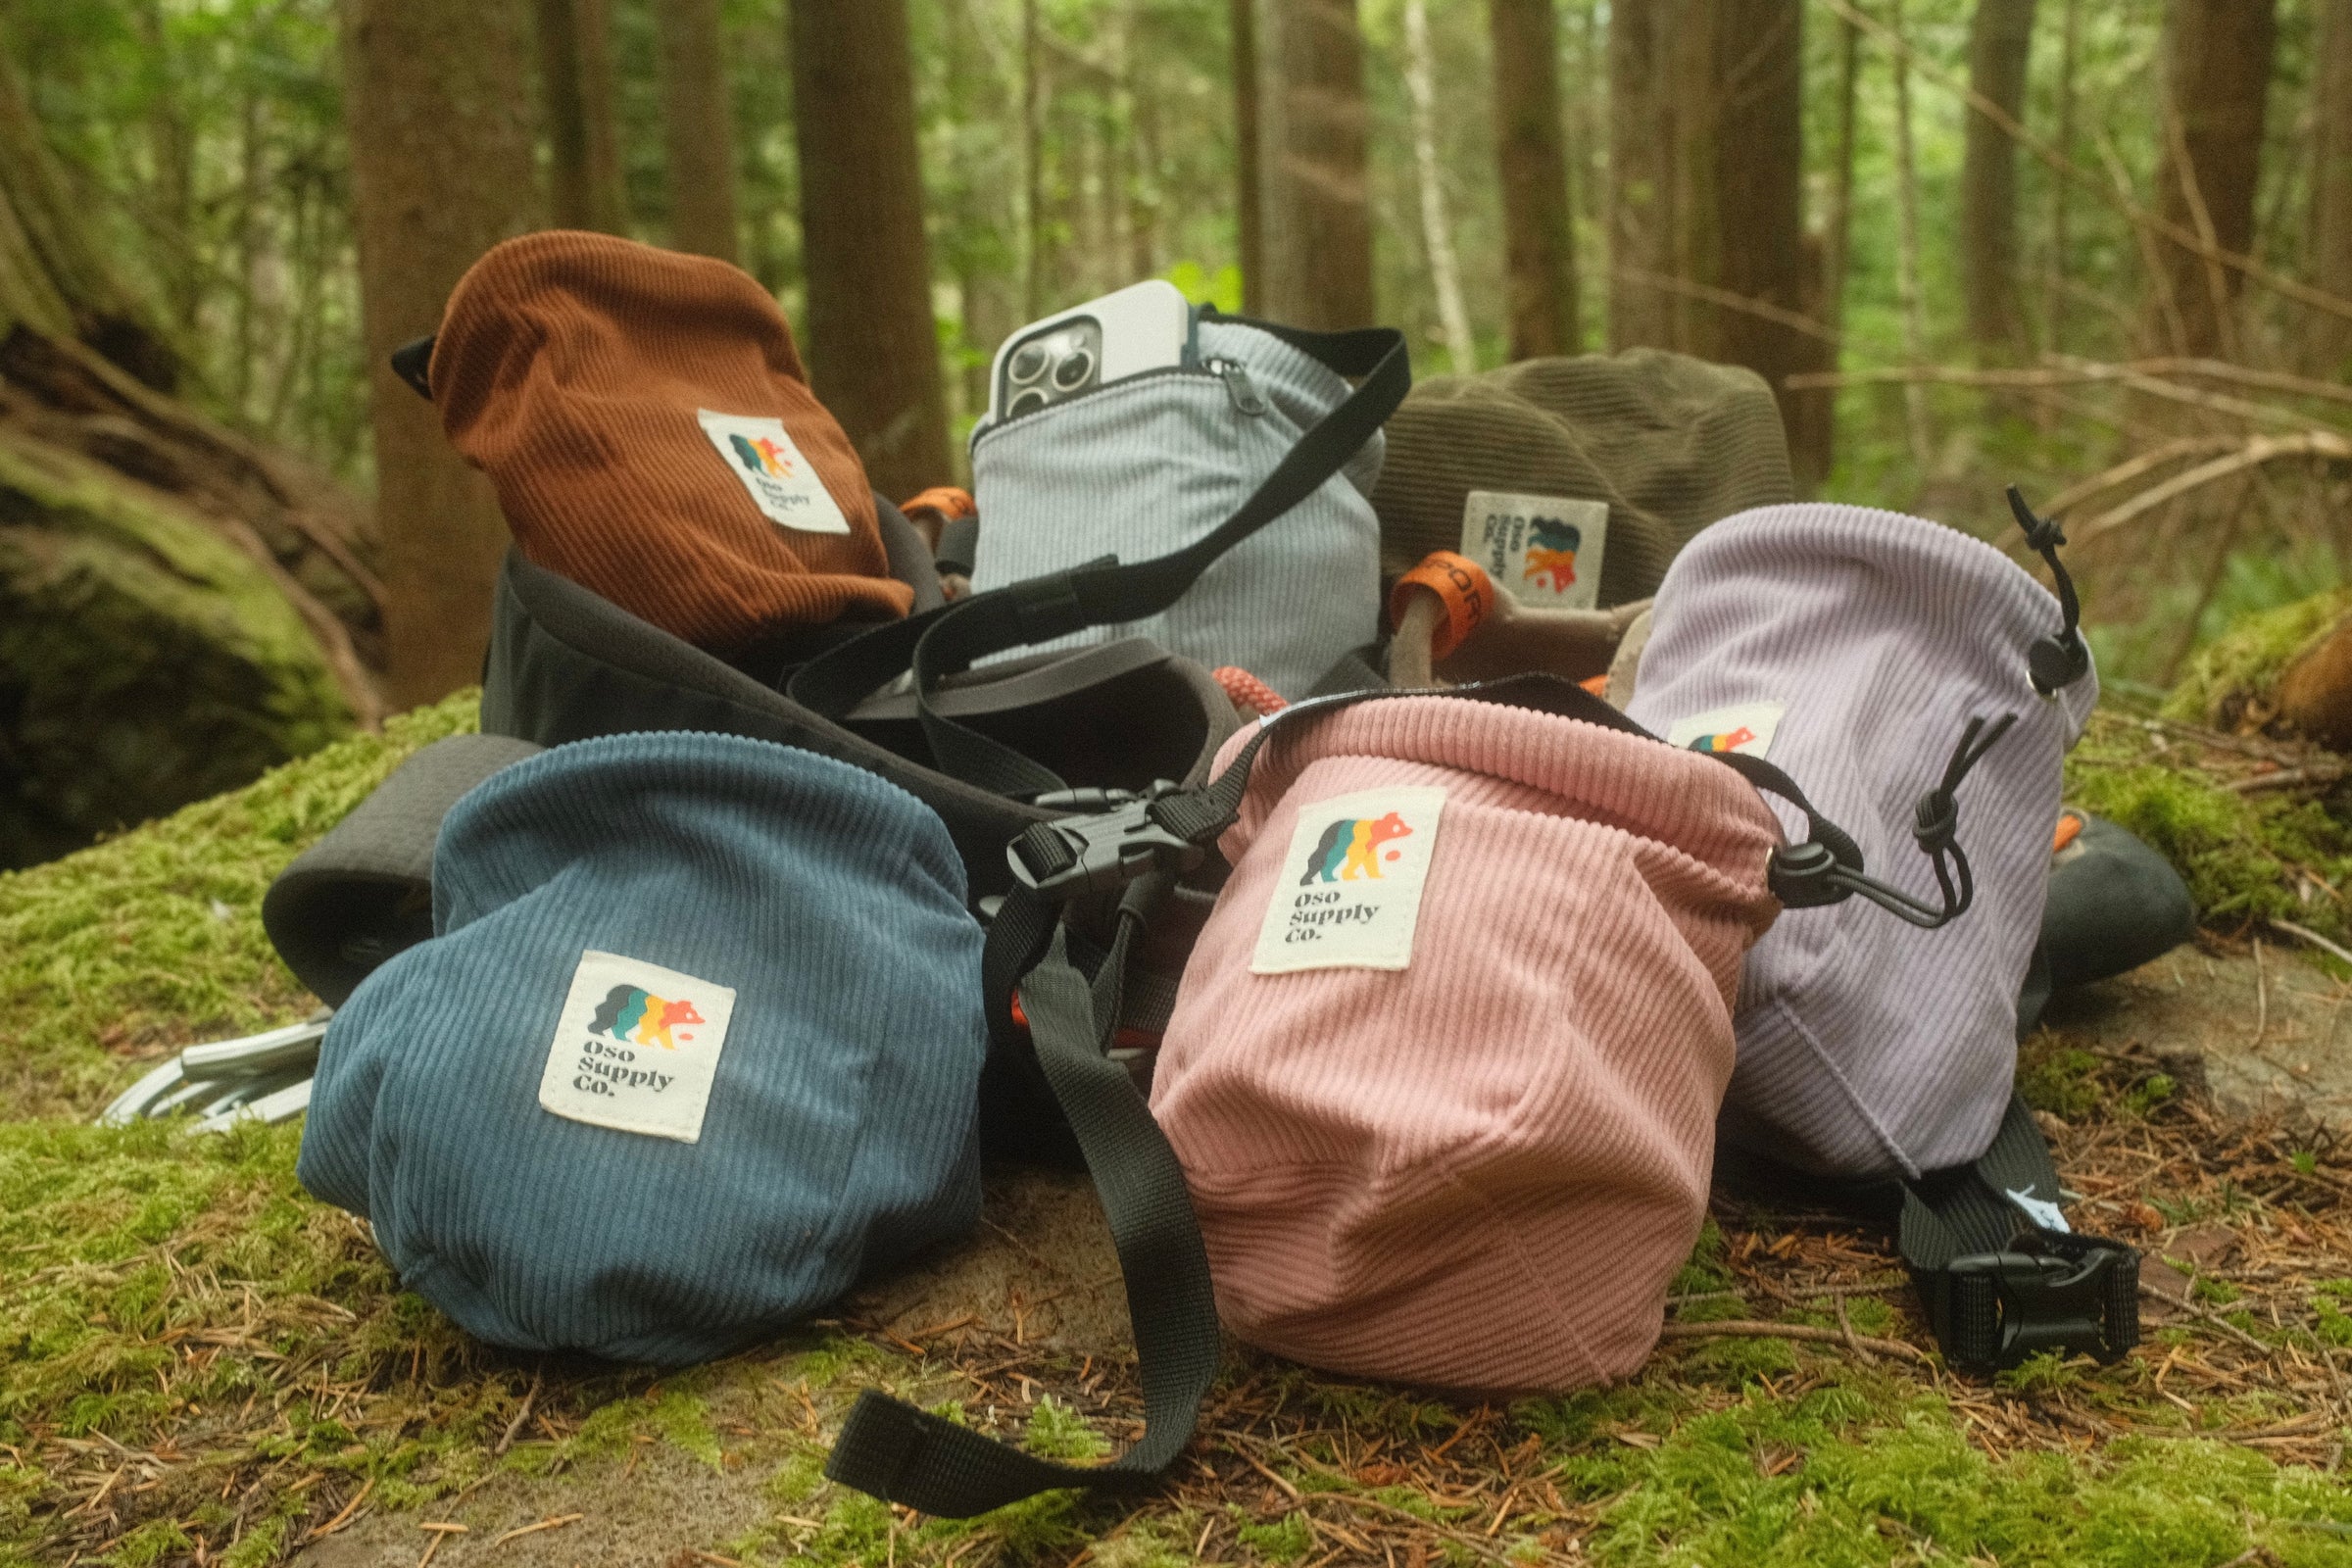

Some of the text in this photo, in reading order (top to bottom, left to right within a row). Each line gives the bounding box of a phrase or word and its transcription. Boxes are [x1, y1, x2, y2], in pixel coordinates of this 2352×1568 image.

[583, 1041, 636, 1062] Oso
[572, 1074, 615, 1098] Co.
[577, 1056, 675, 1093] Supply
